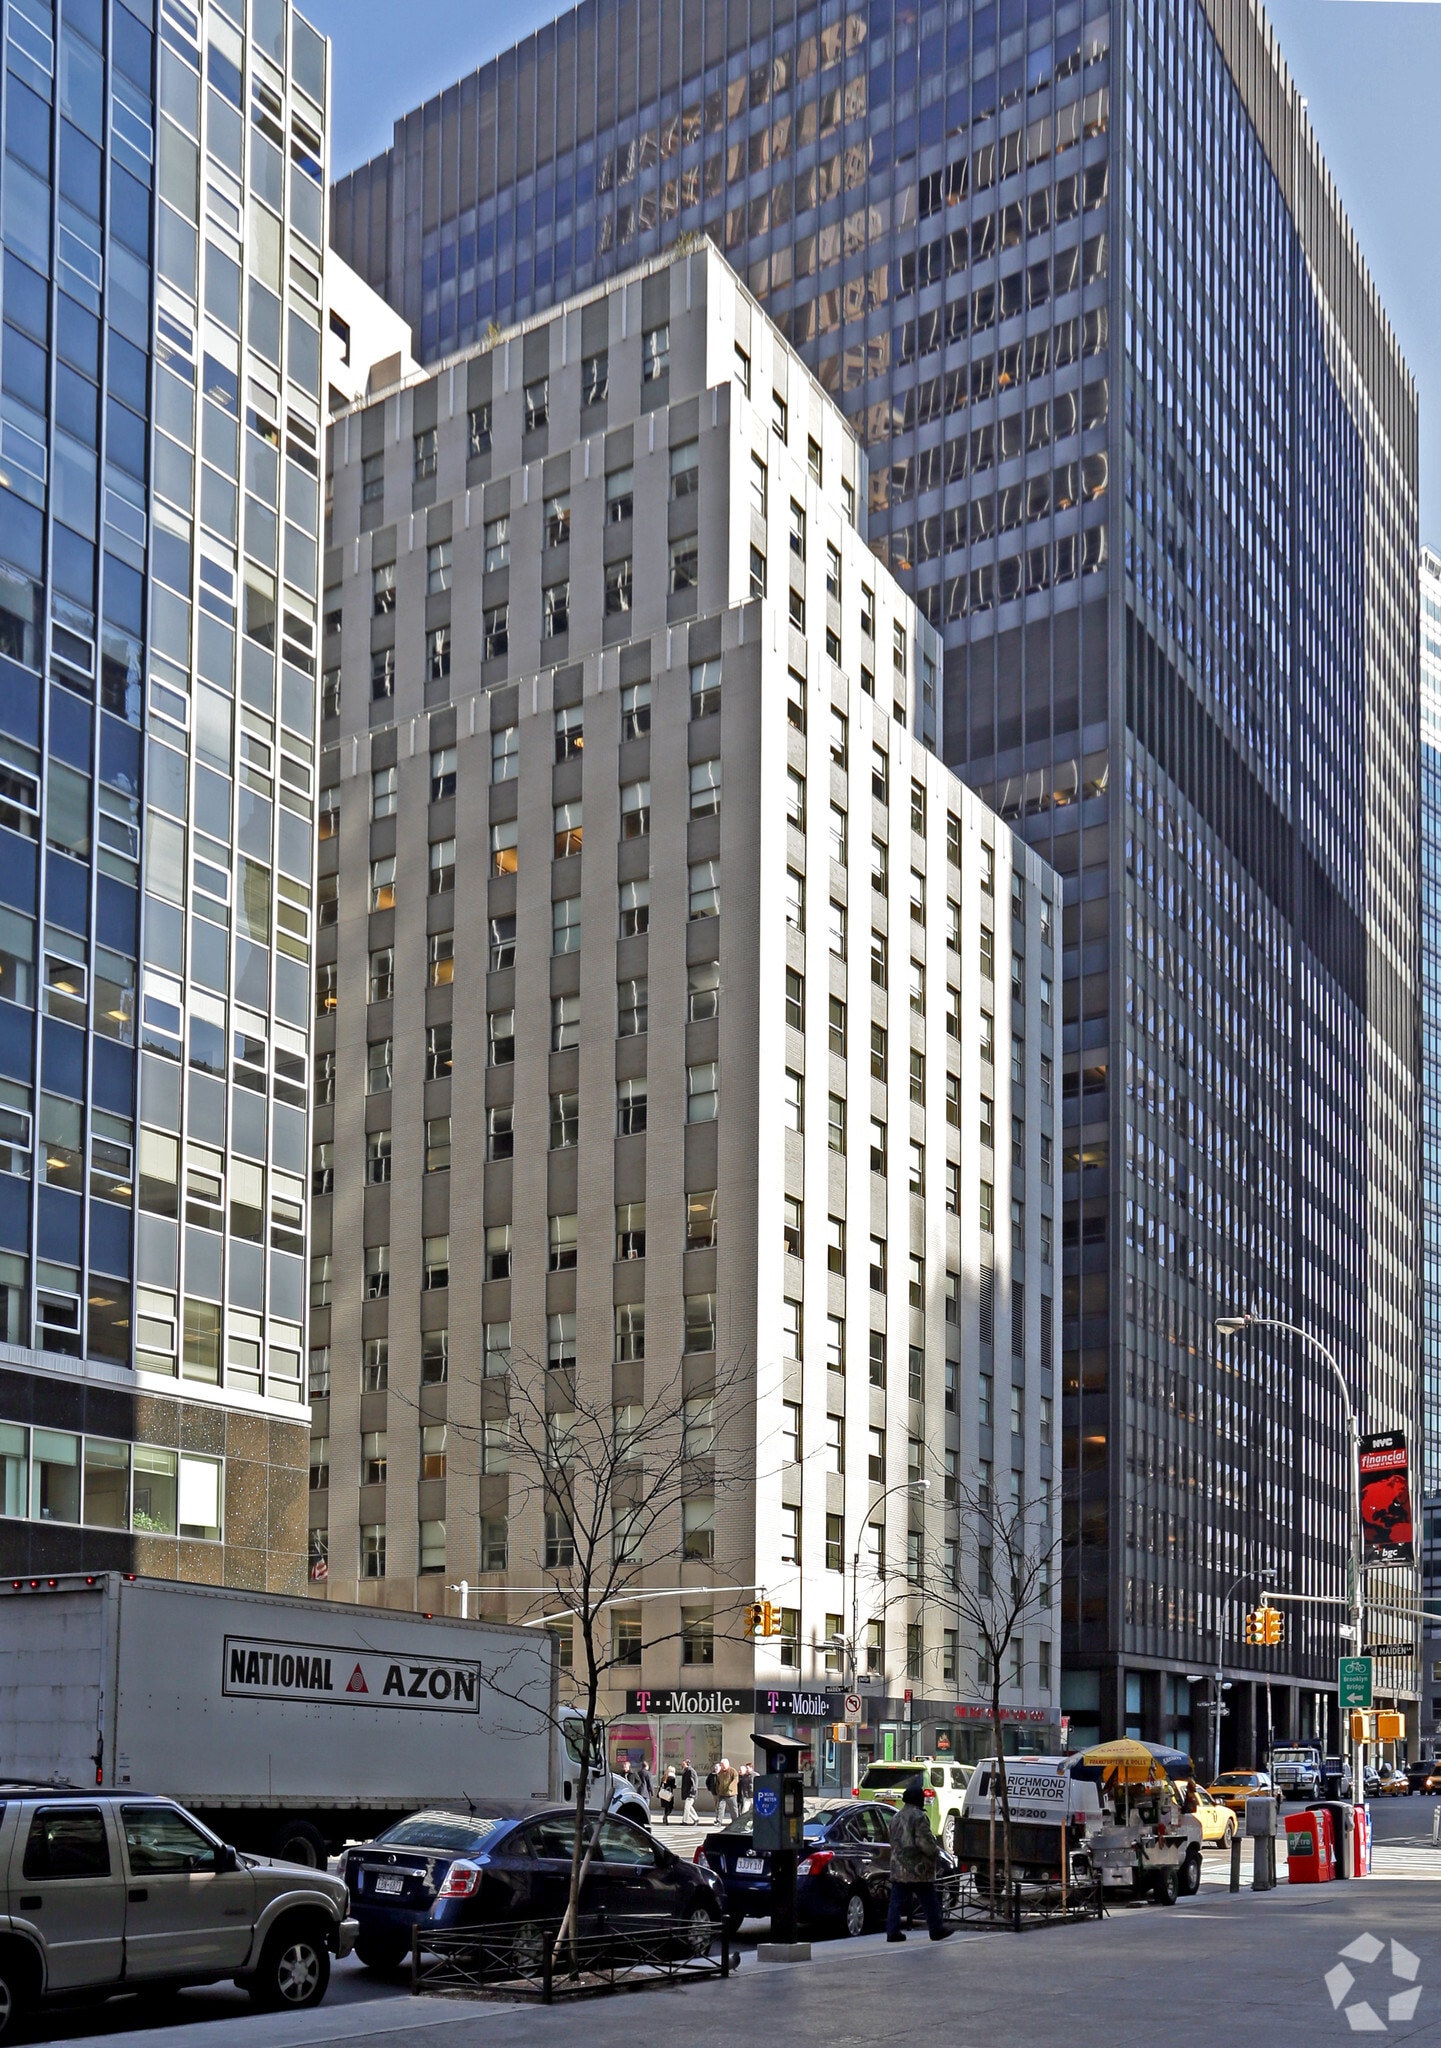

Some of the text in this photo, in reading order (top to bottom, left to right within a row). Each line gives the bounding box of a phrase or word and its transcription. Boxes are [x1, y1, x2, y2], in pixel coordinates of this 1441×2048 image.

[1372, 1437, 1393, 1449] NYC
[1362, 1450, 1405, 1467] financial
[1382, 1548, 1398, 1559] bgc
[1379, 1647, 1407, 1656] MAIDEN
[230, 1649, 475, 1702] NATIONAL AZON
[1007, 1776, 1066, 1789] RICHMOND
[1006, 1786, 1064, 1799] ELEVATOR
[1020, 1809, 1048, 1819] 3200
